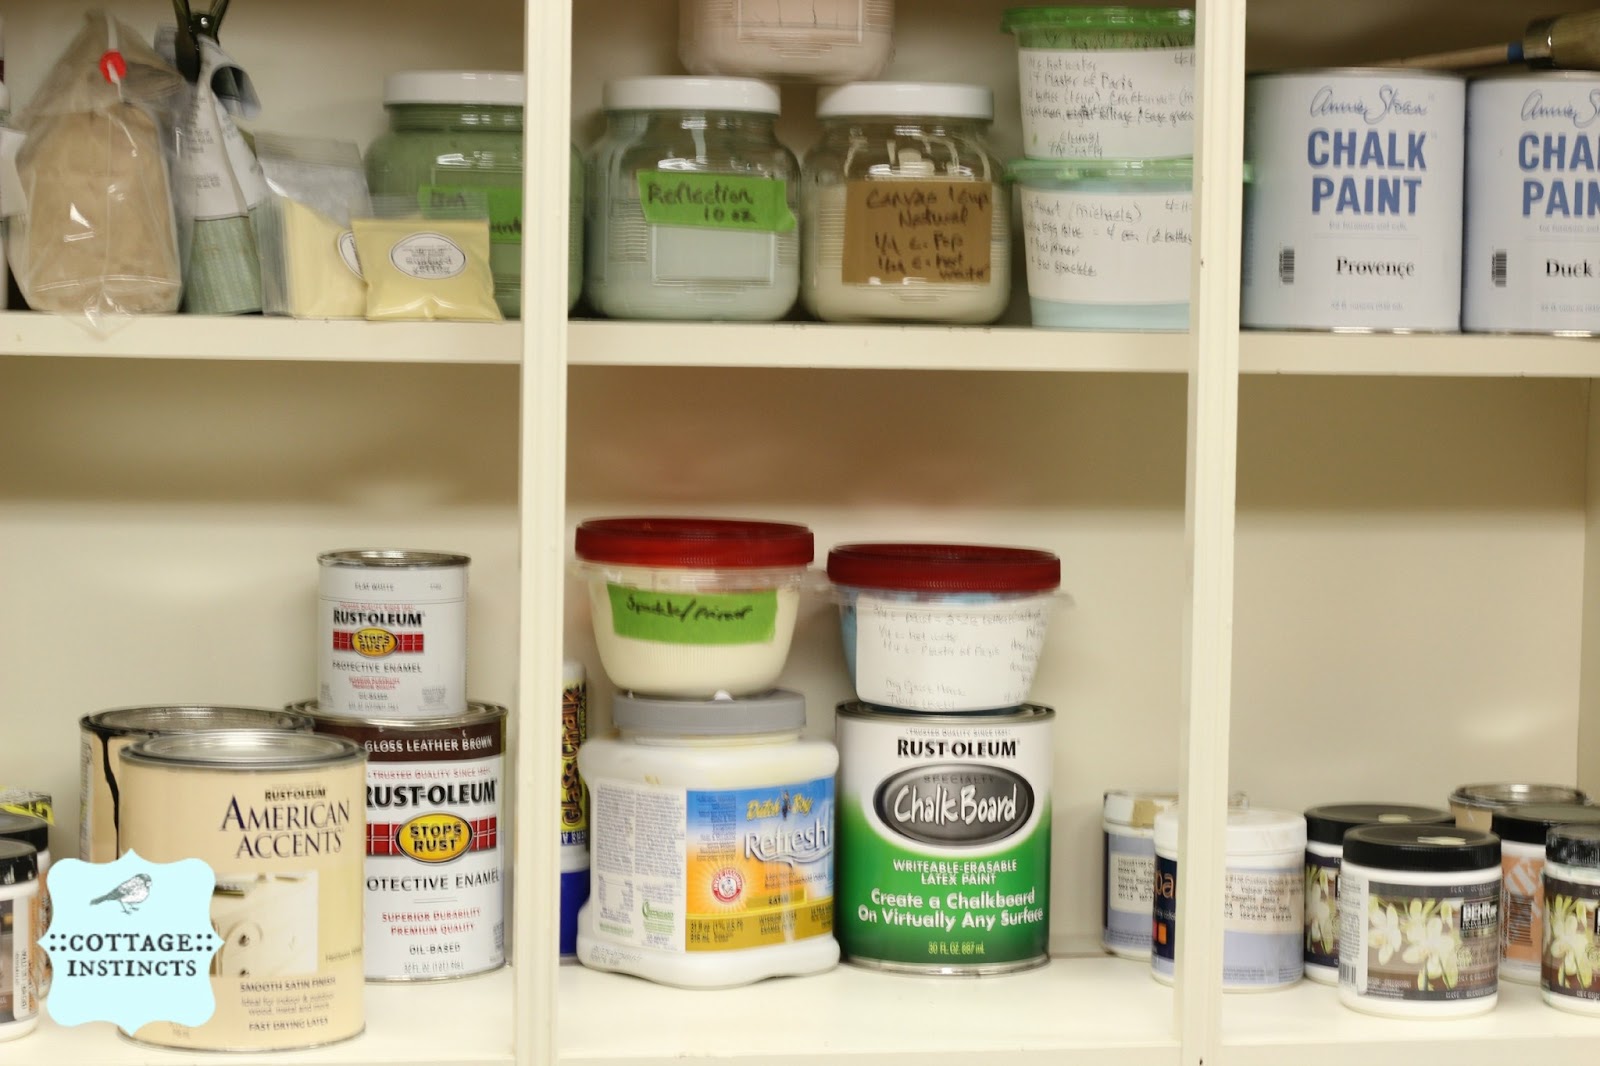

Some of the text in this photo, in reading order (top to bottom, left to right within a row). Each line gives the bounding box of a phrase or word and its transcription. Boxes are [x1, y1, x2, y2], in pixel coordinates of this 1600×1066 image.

[1307, 128, 1428, 171] CHALK
[647, 180, 754, 206] Reflection
[1311, 174, 1422, 217] PAINT
[898, 205, 969, 229] Natural
[1545, 259, 1593, 280] Duck
[359, 643, 388, 654] RUST
[384, 662, 423, 674] ENAMEL
[364, 734, 494, 753] GLOSS LEATHER BROWN
[372, 768, 412, 781] TRUSTED
[415, 768, 451, 781] QUALITY
[219, 793, 350, 832] AMERICAN
[410, 821, 462, 839] STOPS
[744, 815, 831, 862] Refresh
[234, 828, 343, 860] ACCENTS
[413, 837, 459, 854] RUST
[366, 867, 500, 893] OTECTIVE ENAMEL
[920, 872, 997, 886] LATEX PAINT
[871, 886, 1036, 910] Create a Chalkboard
[382, 906, 482, 924] SUPERIOR DURABILITY
[857, 903, 1045, 933] On Virtually Any Surface
[390, 921, 476, 937] PREMIUM QUALITY
[239, 982, 283, 994] SMOOTH
[285, 980, 311, 992] SATIN
[248, 1021, 271, 1032] FAST
[272, 1019, 306, 1031] DRYING
